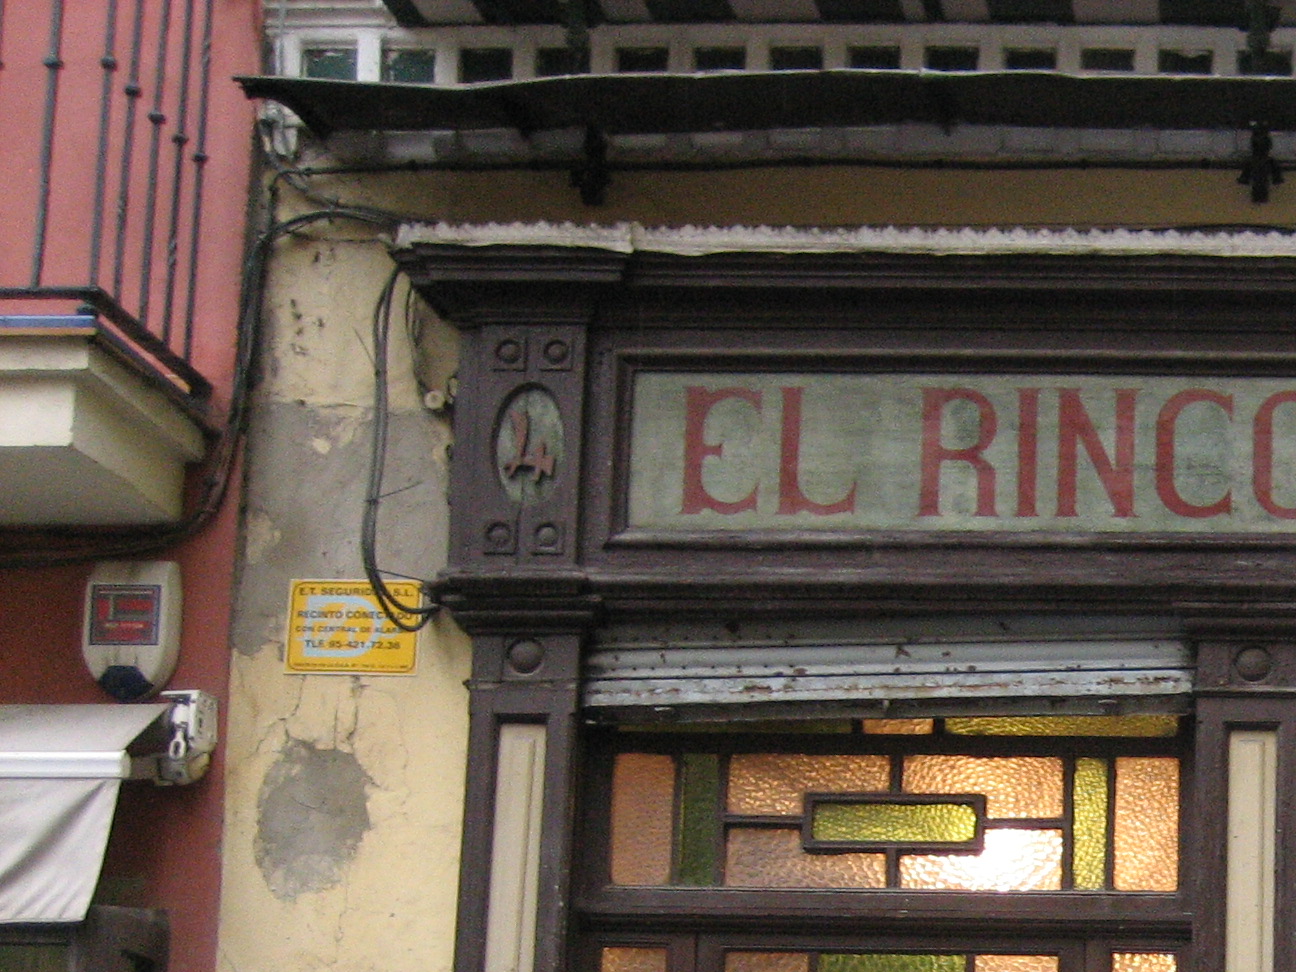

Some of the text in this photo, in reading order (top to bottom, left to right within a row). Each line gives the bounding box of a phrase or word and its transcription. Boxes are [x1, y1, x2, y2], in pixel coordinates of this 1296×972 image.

[679, 385, 857, 516] EL
[321, 588, 376, 597] SEGURID
[298, 610, 344, 619] RECINTO
